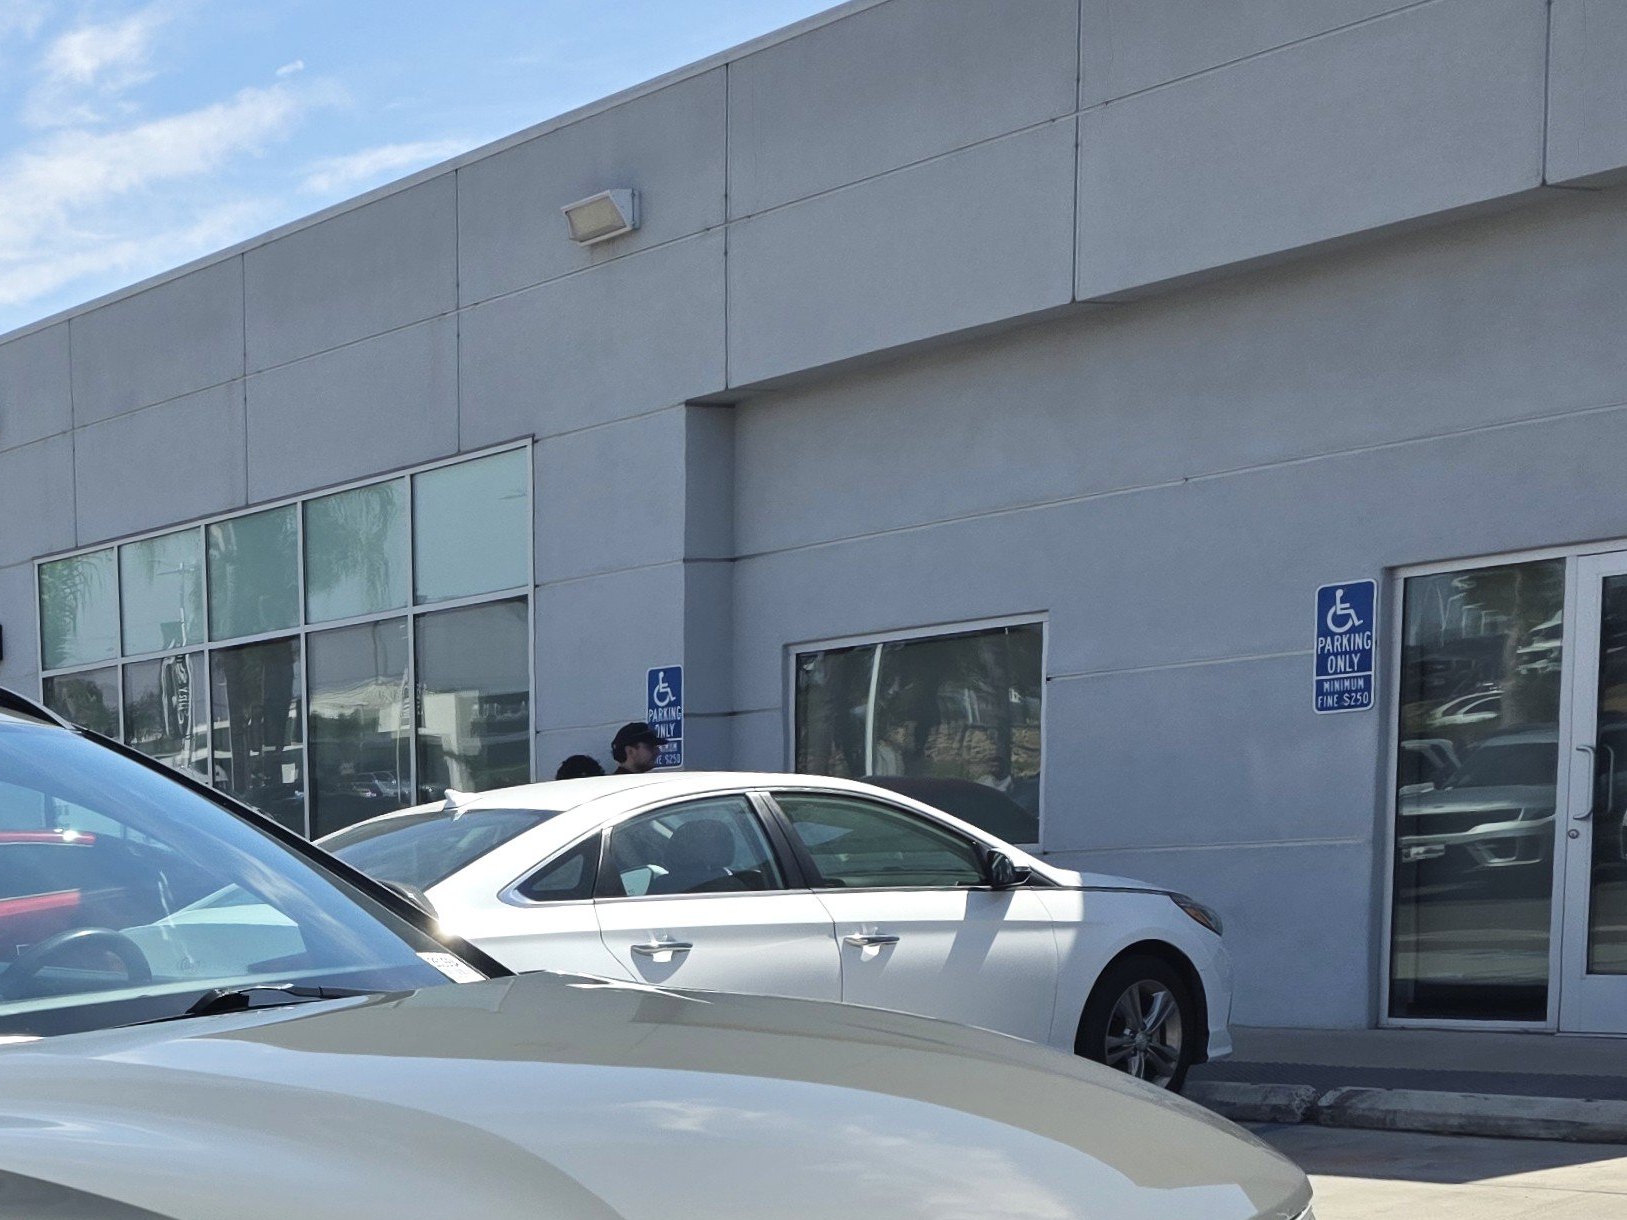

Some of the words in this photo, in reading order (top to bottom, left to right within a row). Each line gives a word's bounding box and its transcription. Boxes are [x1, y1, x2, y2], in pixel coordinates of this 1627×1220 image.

[1318, 631, 1371, 655] PARKING
[1327, 653, 1361, 674] ONLY
[1323, 678, 1364, 693] MINIMUM
[1318, 694, 1339, 708] FINE
[1343, 691, 1369, 706] $250
[648, 706, 682, 722] PARKING
